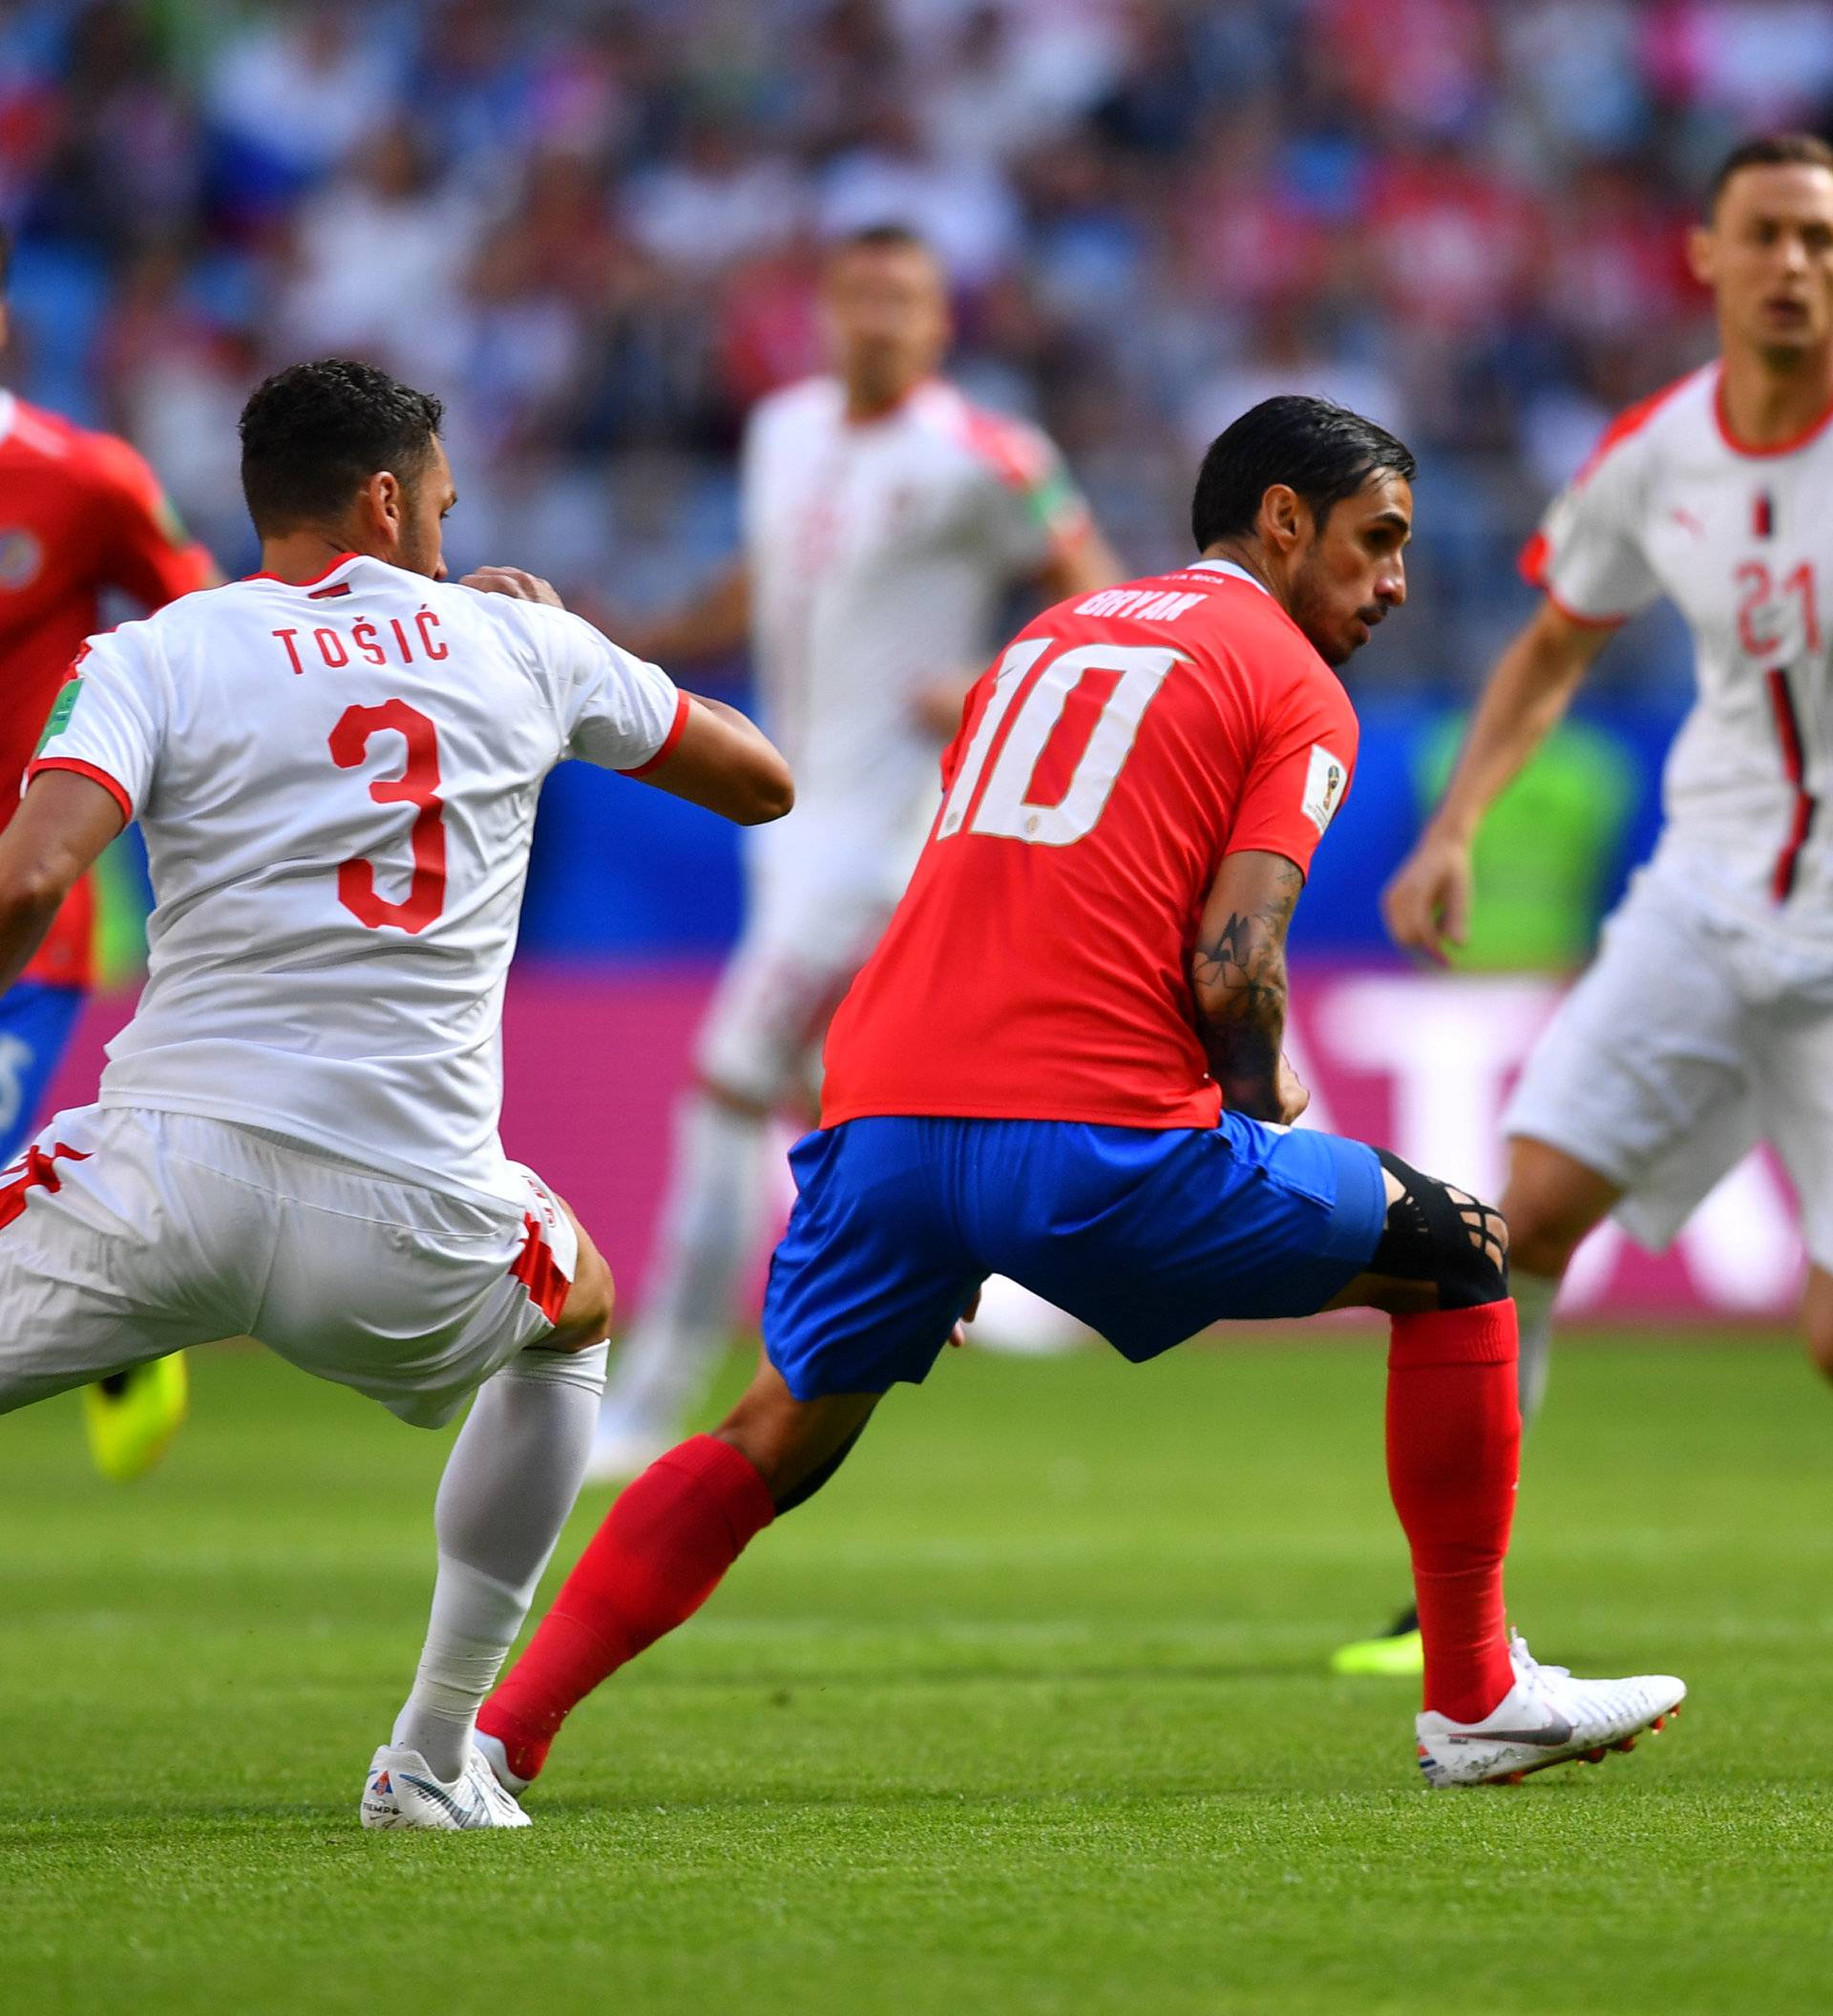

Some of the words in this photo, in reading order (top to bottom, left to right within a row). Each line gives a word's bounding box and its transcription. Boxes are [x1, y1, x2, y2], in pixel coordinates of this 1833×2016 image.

[272, 603, 449, 675] TOŠIĆ
[1073, 589, 1209, 621] BRYAN
[1734, 560, 1822, 658] 21
[937, 637, 1197, 846] 10
[327, 698, 447, 935] 3
